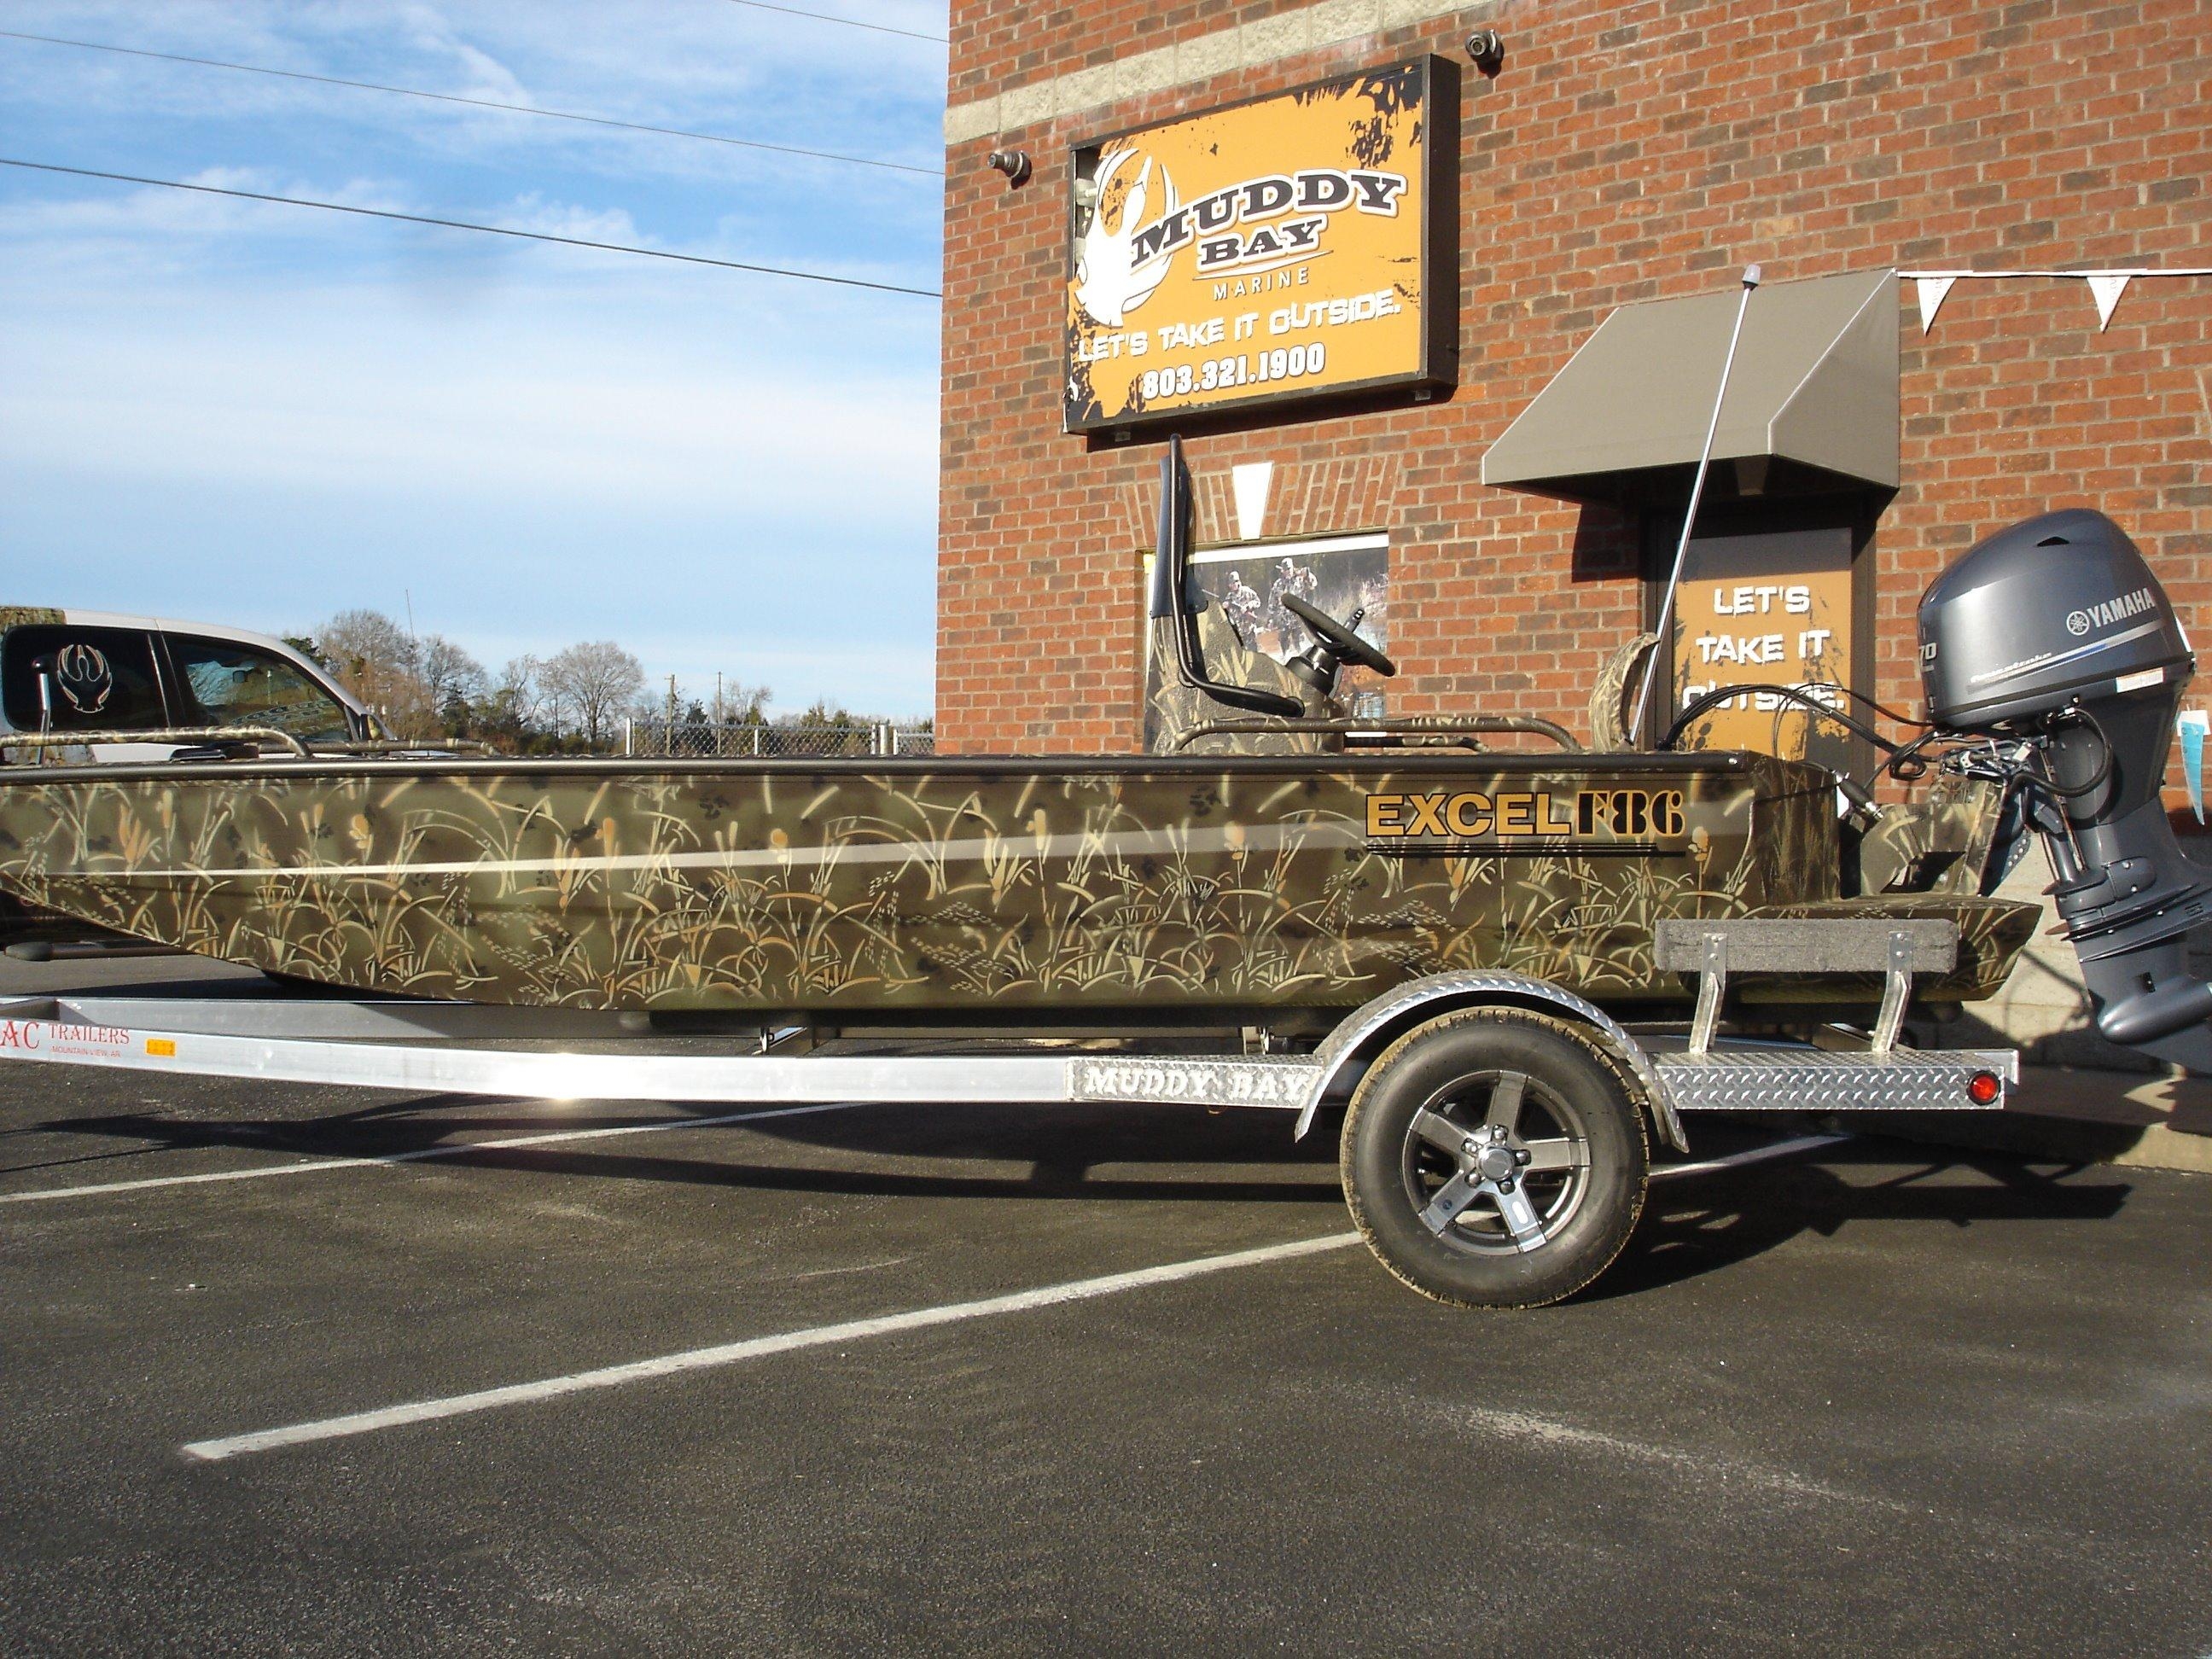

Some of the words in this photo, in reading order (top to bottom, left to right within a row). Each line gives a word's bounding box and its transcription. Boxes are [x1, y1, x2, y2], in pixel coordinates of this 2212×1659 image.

[1131, 169, 1408, 271] MUDDY
[1196, 214, 1328, 272] BAY
[1214, 266, 1309, 301] MARINE
[1079, 331, 1149, 362] LET'S
[1157, 314, 1225, 349] TAKE
[1234, 311, 1260, 341] IT
[1269, 288, 1401, 335] OUTSIDE.
[1142, 342, 1326, 400] 803.321.1900
[1714, 585, 1811, 616] LET'S
[2087, 588, 2157, 629] YAMAHA
[1696, 633, 1785, 665] TAKE
[1797, 629, 1831, 660] IT
[1365, 791, 1571, 837] EXCEL
[48, 1023, 130, 1045] TRAILERS
[1084, 1066, 1216, 1098] MUDDY
[1228, 1071, 1311, 1103] BAY
